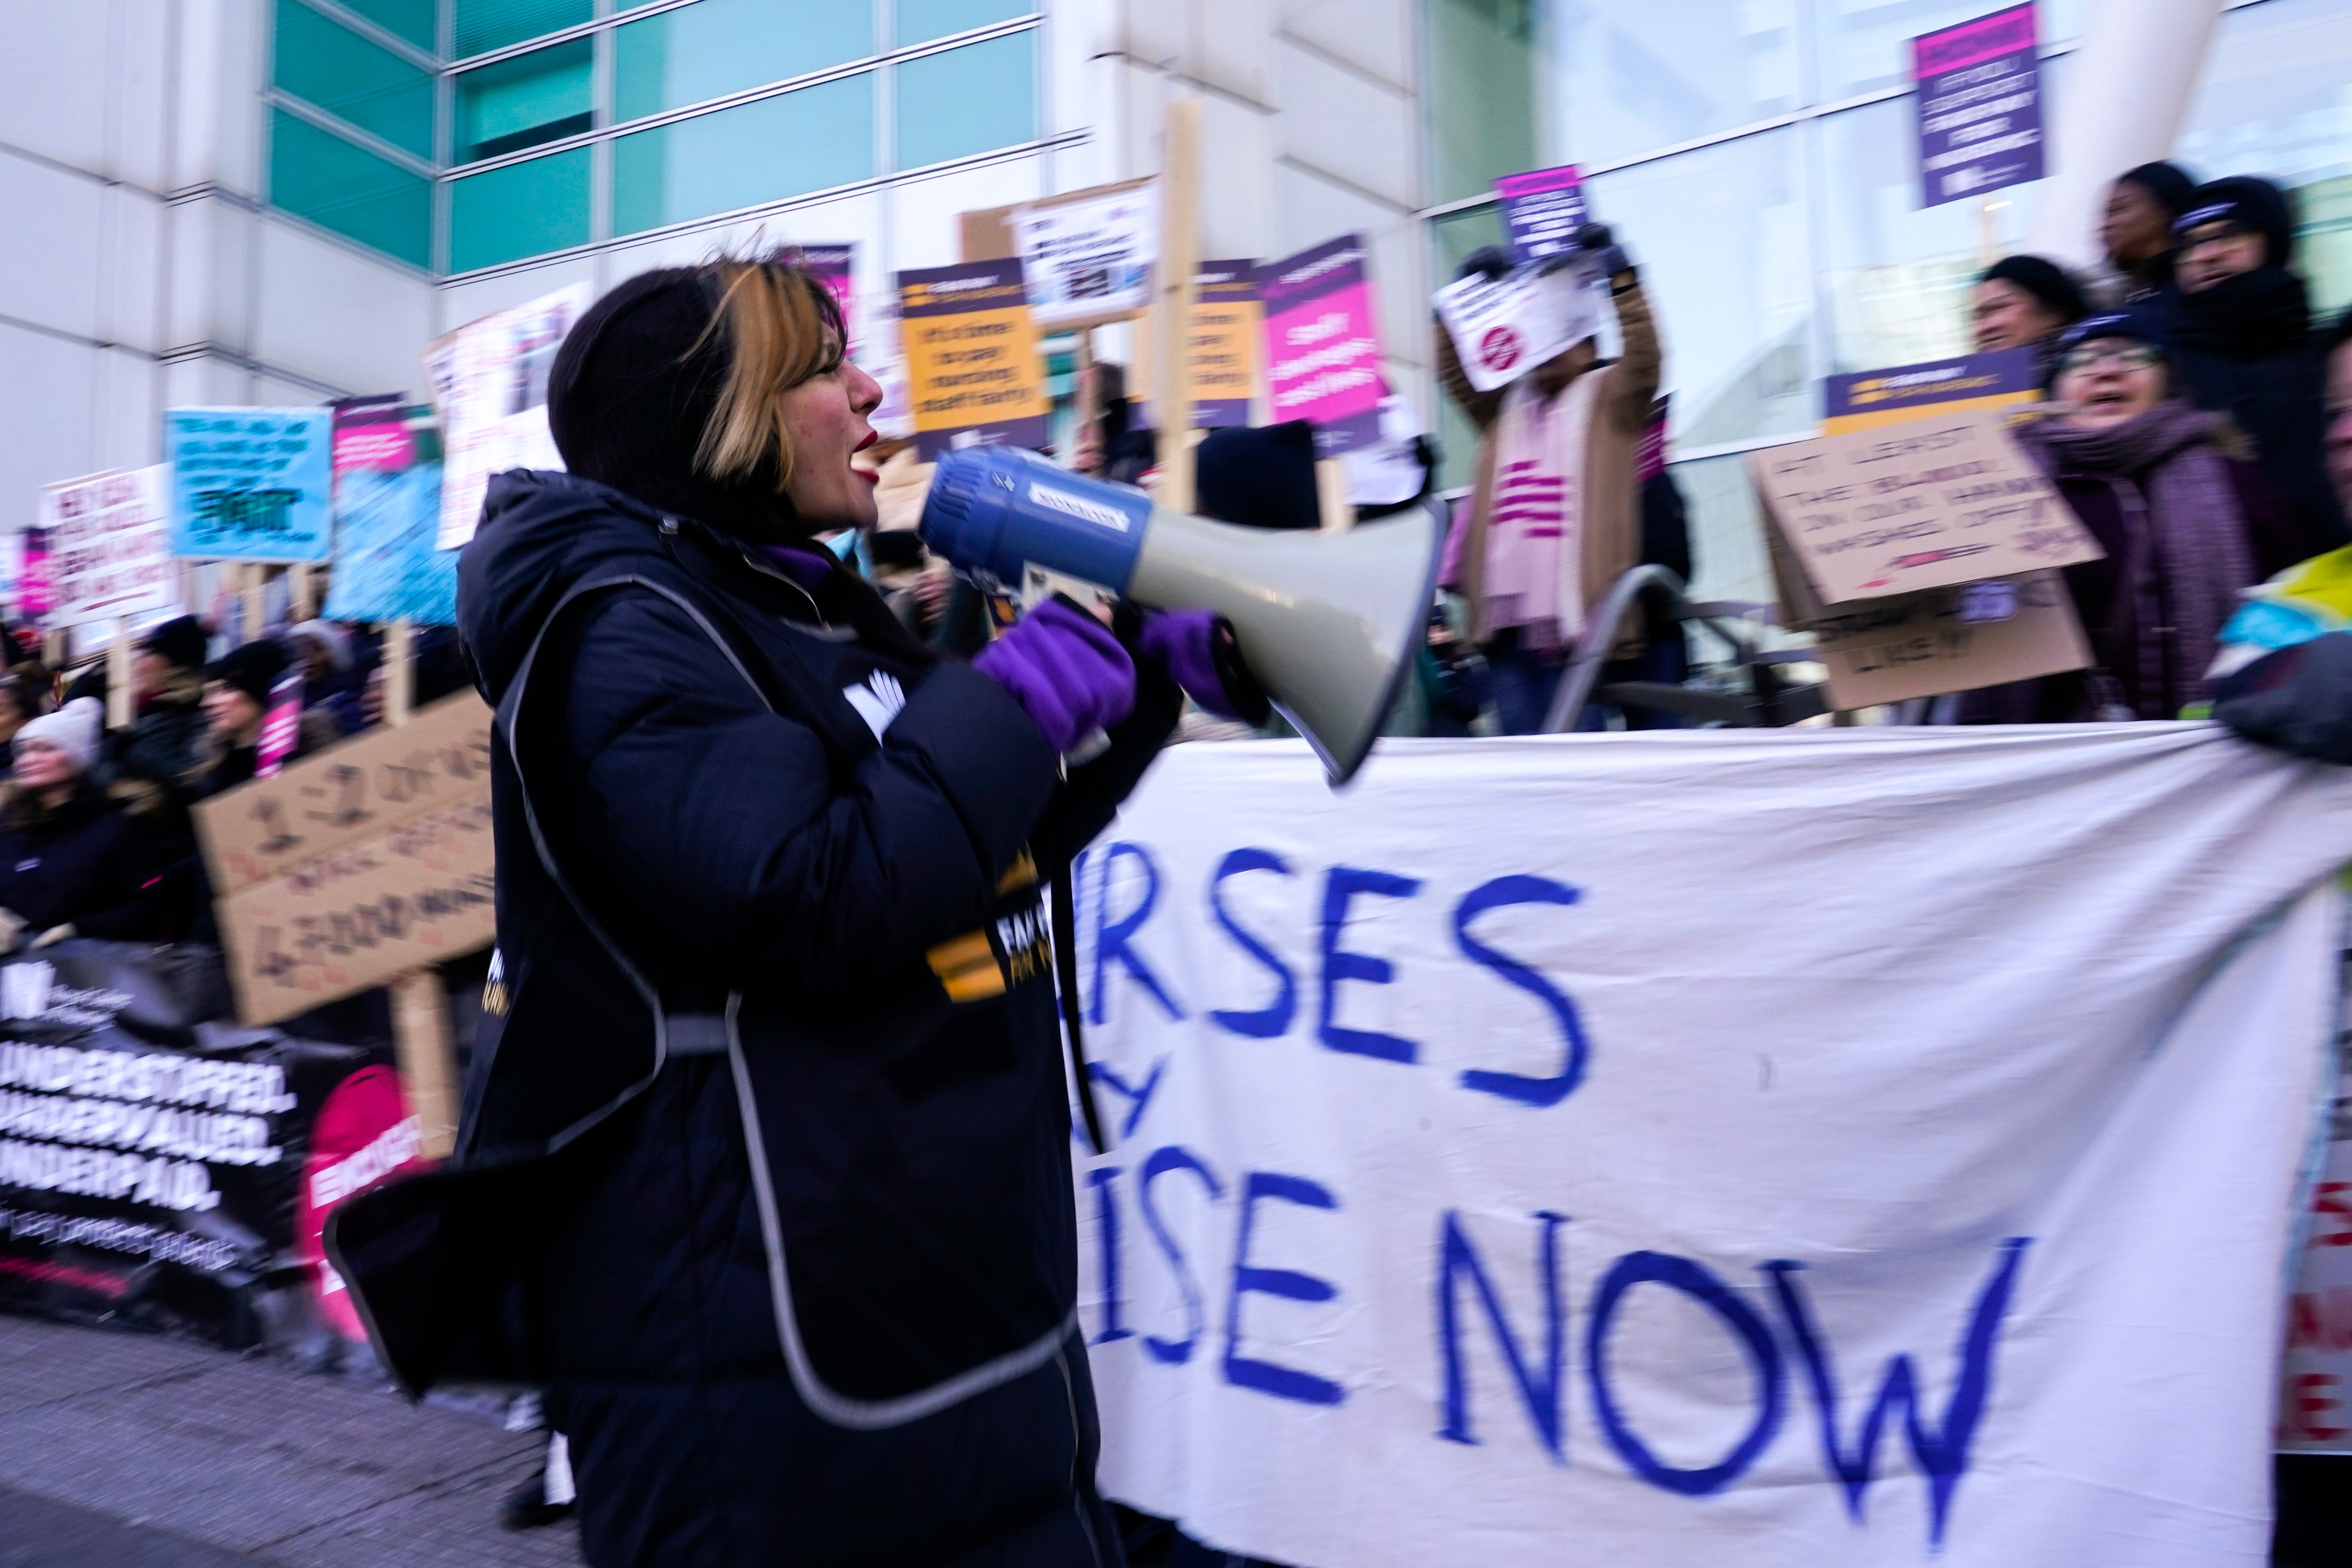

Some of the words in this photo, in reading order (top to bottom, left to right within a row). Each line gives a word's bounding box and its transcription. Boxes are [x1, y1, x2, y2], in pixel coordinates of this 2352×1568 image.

[1058, 841, 1592, 1109] RSES
[0, 1140, 222, 1211] NDERPAID.
[1083, 1143, 1348, 1407] ISE
[1433, 1206, 2035, 1560] NOW
